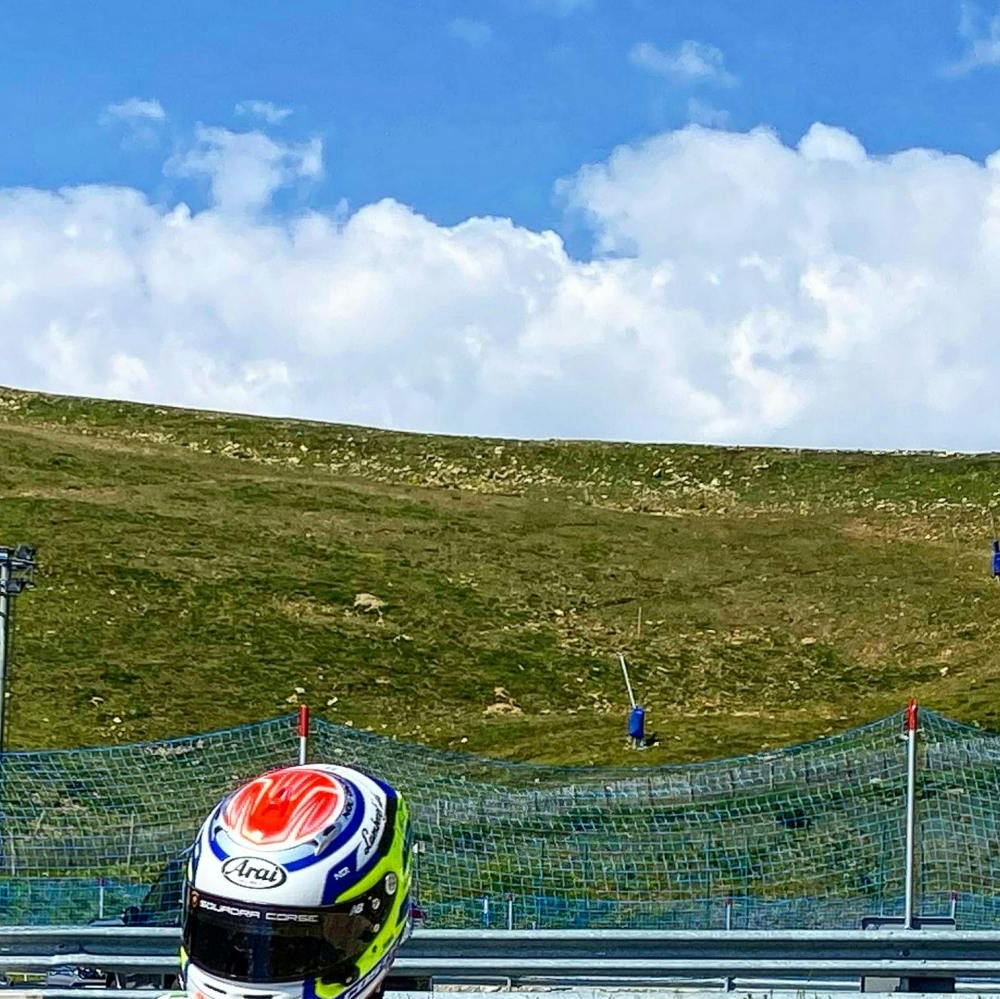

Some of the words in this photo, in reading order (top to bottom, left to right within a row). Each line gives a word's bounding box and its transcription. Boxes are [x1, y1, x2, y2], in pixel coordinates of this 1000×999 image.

[224, 859, 279, 882] Arai
[199, 899, 260, 919] SQUADRA
[265, 912, 319, 922] CORSE
